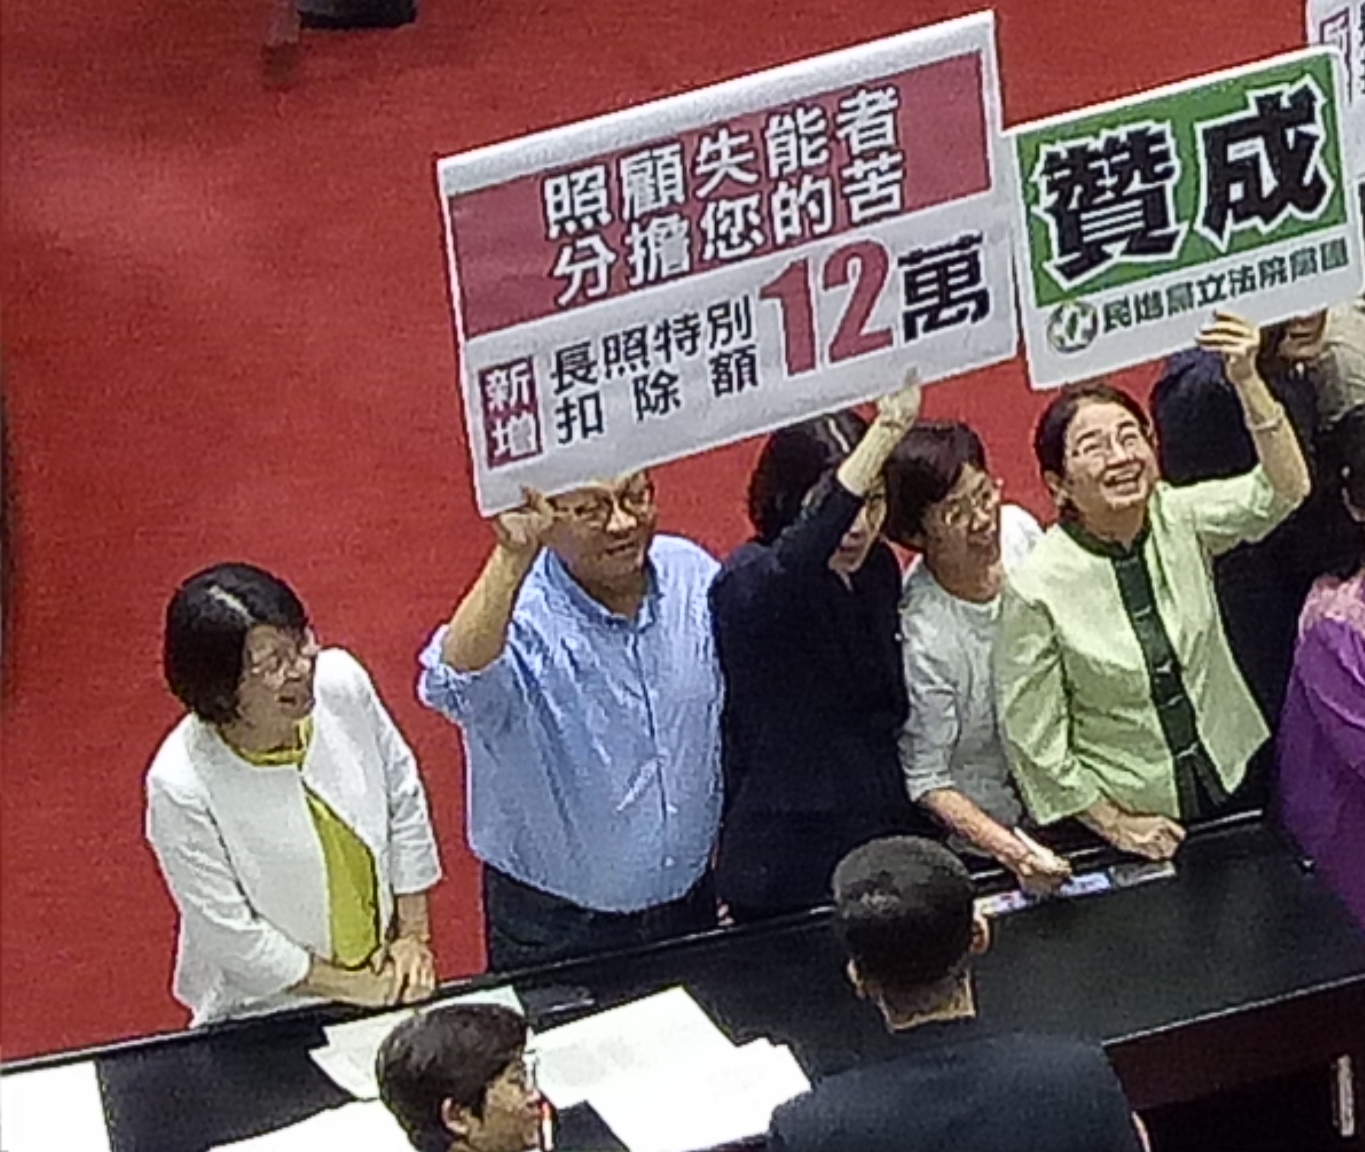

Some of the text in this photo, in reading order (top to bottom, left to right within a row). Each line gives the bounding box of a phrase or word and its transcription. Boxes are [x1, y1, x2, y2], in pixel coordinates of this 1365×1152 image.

[543, 85, 900, 238] 照顧失能者
[555, 153, 903, 305] 分擔您的苦
[550, 295, 752, 394] 長照特別
[761, 230, 992, 377] 12萬
[484, 361, 540, 460] 新增
[555, 342, 759, 444] 扣除額
